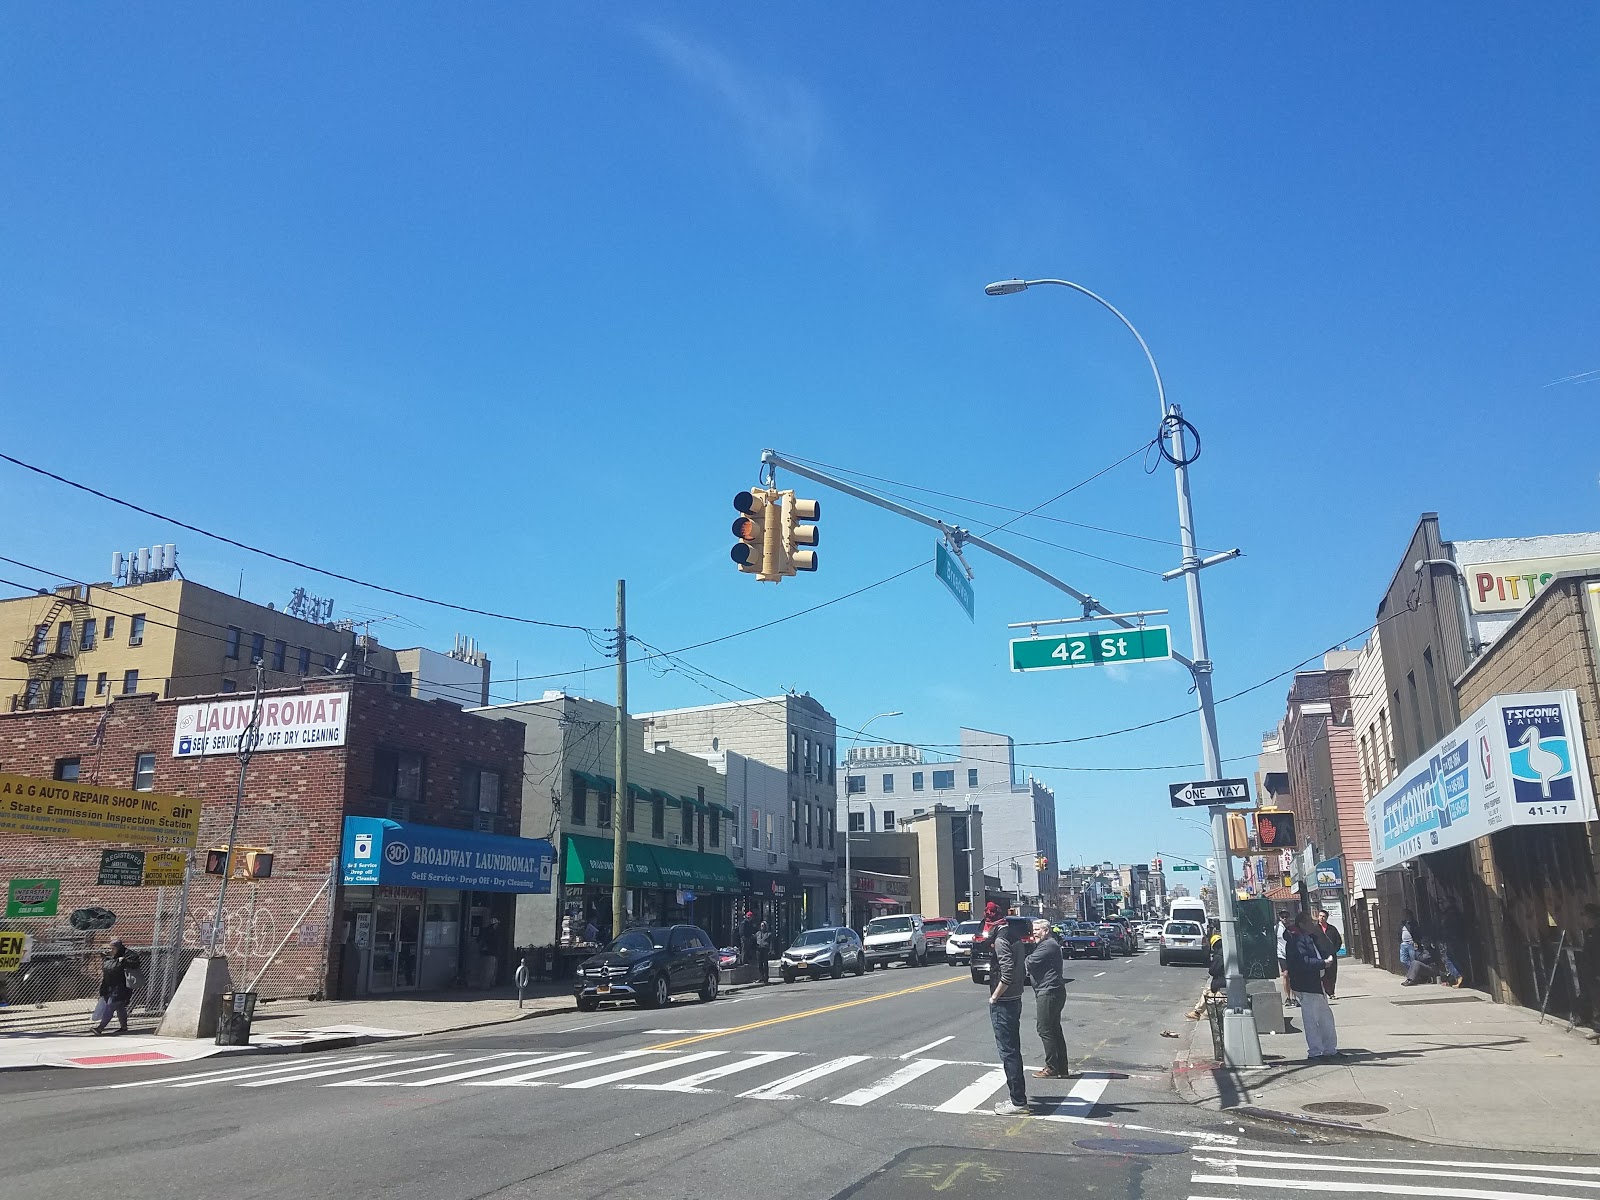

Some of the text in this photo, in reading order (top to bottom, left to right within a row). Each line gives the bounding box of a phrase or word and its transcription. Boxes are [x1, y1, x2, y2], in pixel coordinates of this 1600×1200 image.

[1052, 637, 1128, 661] 42 St
[195, 698, 341, 733] LAUNDROMAT
[1506, 707, 1559, 720] TSIGONIA
[1507, 717, 1560, 726] PAINTS
[192, 737, 209, 751] SELF
[212, 734, 243, 750] SERVICE
[267, 731, 281, 746] OFF
[284, 730, 299, 745] DRY
[302, 728, 339, 743] CLEANING
[3, 783, 12, 793] A
[16, 784, 23, 795] &
[28, 785, 36, 796] G
[39, 787, 70, 800] AUTO
[72, 791, 110, 805] REPAIR
[112, 796, 139, 809] SHOP
[141, 799, 160, 811] INC.
[1185, 785, 1242, 800] ONE WAY
[10, 801, 42, 813] State
[47, 805, 103, 820] Emmission
[106, 812, 155, 825] Inspection
[158, 817, 192, 829] Station
[1385, 780, 1434, 840] TSIGONIA
[1528, 805, 1568, 816] 41-17
[1399, 836, 1422, 858] PAINTS
[105, 852, 142, 865] REGISTERED
[152, 853, 180, 862] OFFICIAL
[388, 845, 407, 860] 301
[413, 846, 473, 868] BROADWAY
[475, 852, 535, 873] LAUNDROMAT
[589, 859, 615, 870] BROADWA
[411, 871, 534, 888] Self Service Drop Off Dry Cleaning
[202, 928, 224, 936] PARNG
[0, 937, 23, 954] EN
[0, 957, 20, 968] SHOP
